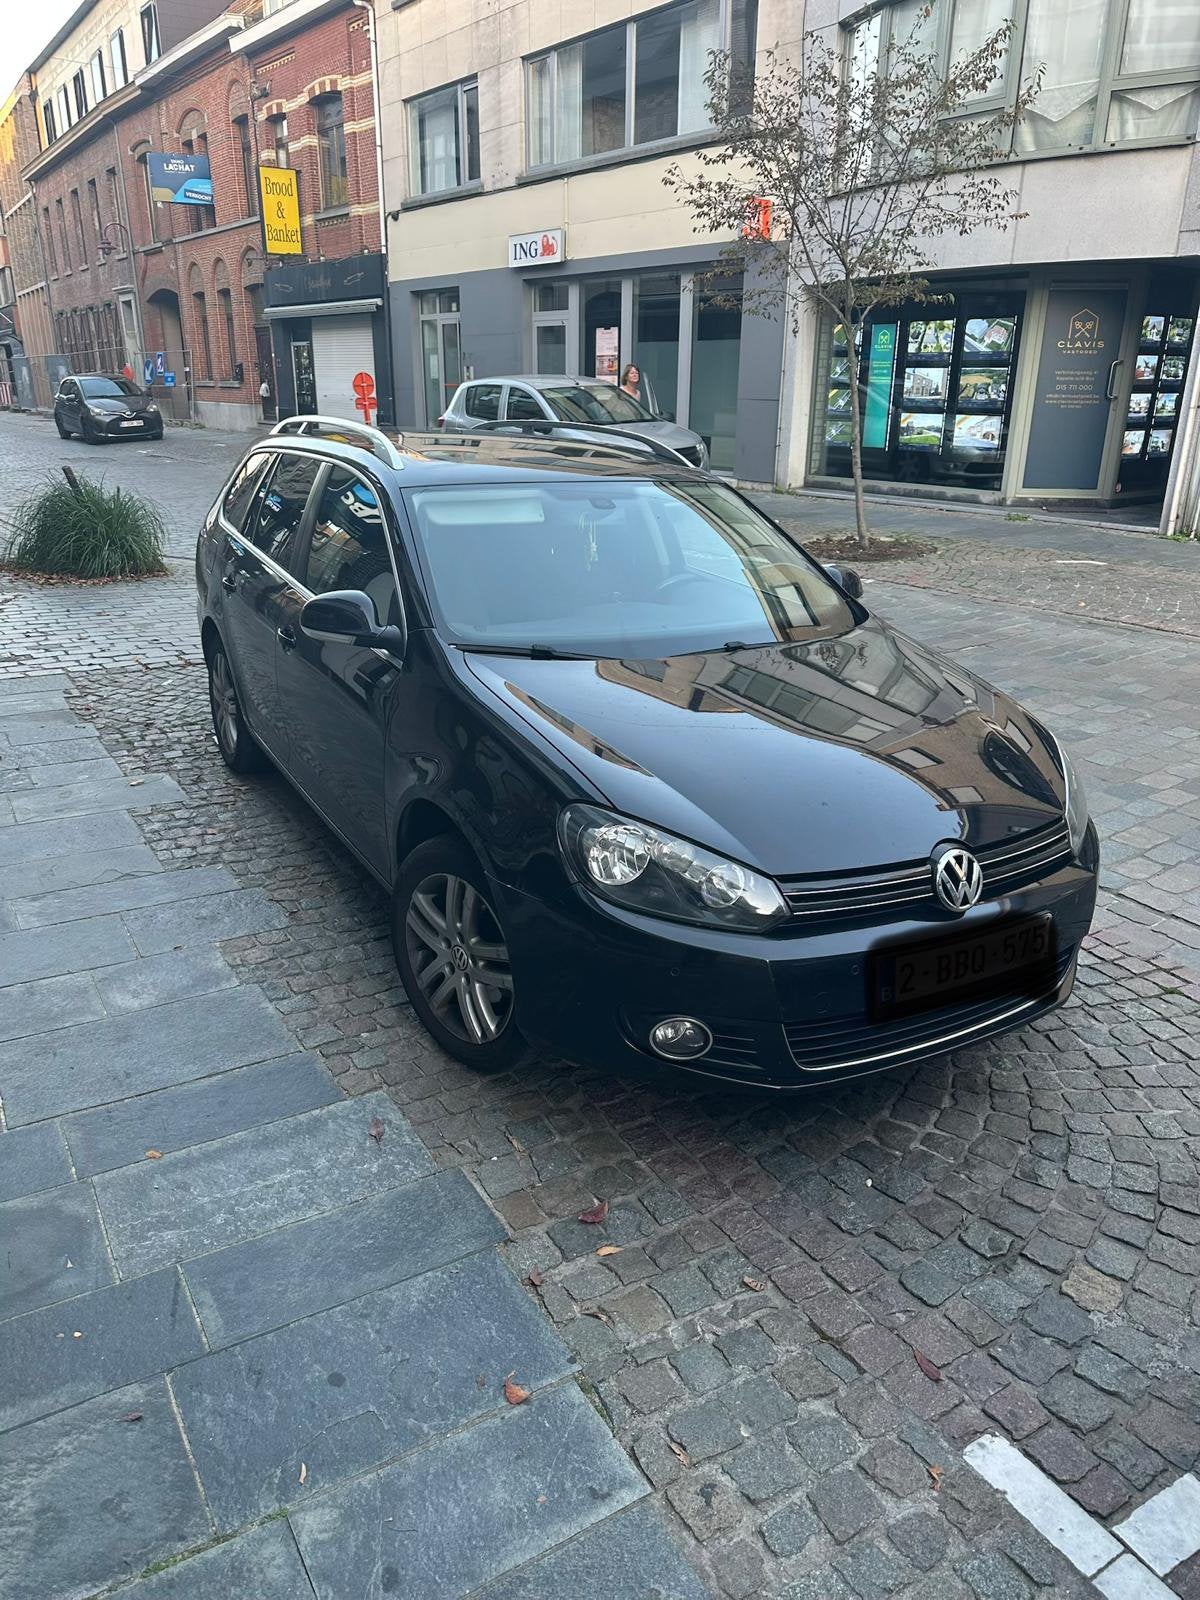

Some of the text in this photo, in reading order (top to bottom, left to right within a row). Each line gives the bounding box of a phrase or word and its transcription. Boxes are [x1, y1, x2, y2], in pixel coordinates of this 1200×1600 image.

[163, 163, 196, 171] LACHAT
[264, 176, 294, 196] Brood
[276, 201, 286, 219] &
[266, 223, 300, 243] Banket
[513, 240, 539, 260] ING
[1057, 340, 1105, 348] CLAVIS
